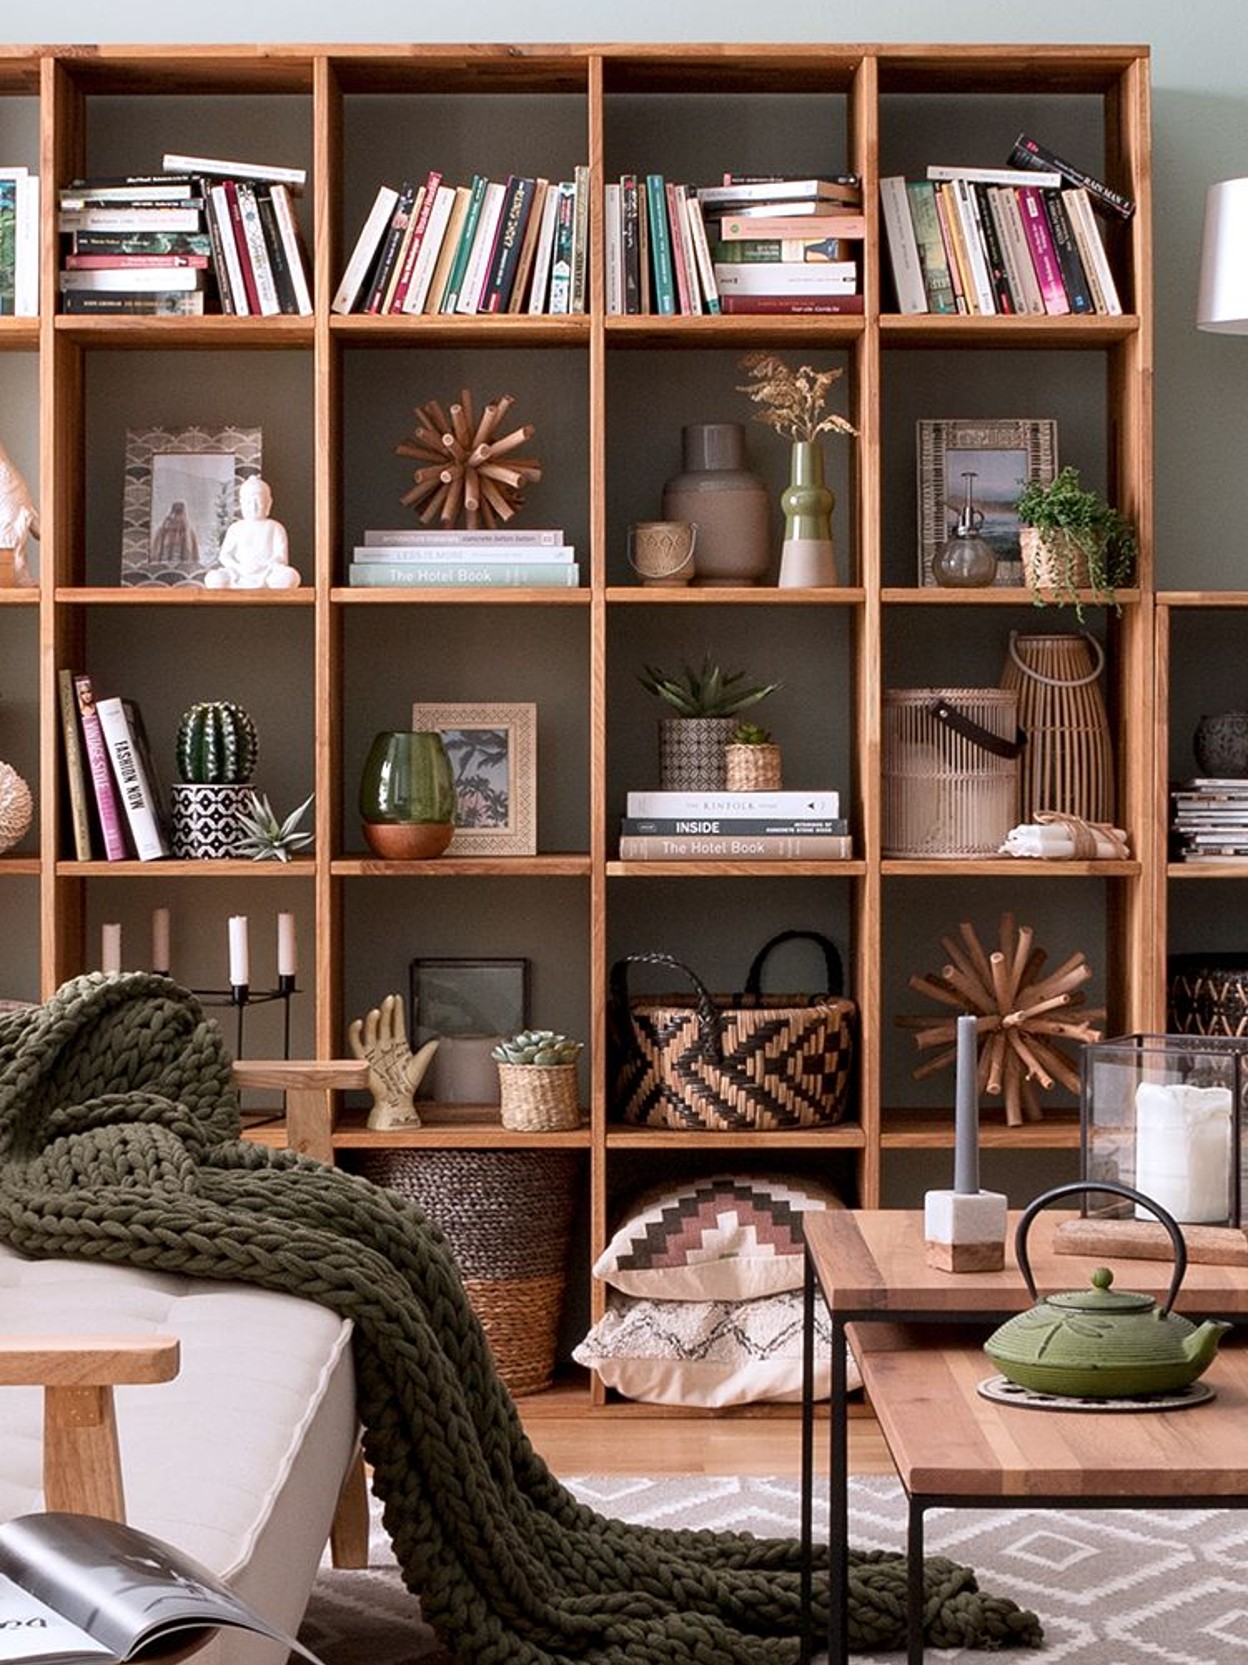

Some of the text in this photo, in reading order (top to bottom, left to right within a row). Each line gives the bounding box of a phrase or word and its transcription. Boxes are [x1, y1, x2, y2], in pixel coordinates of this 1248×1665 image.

[390, 569, 491, 582] The Hotel Book
[114, 740, 146, 810] FASHION NOW
[703, 802, 756, 810] KINFOLK
[676, 821, 720, 833] INSIDE
[662, 841, 764, 854] The Hotel Book
